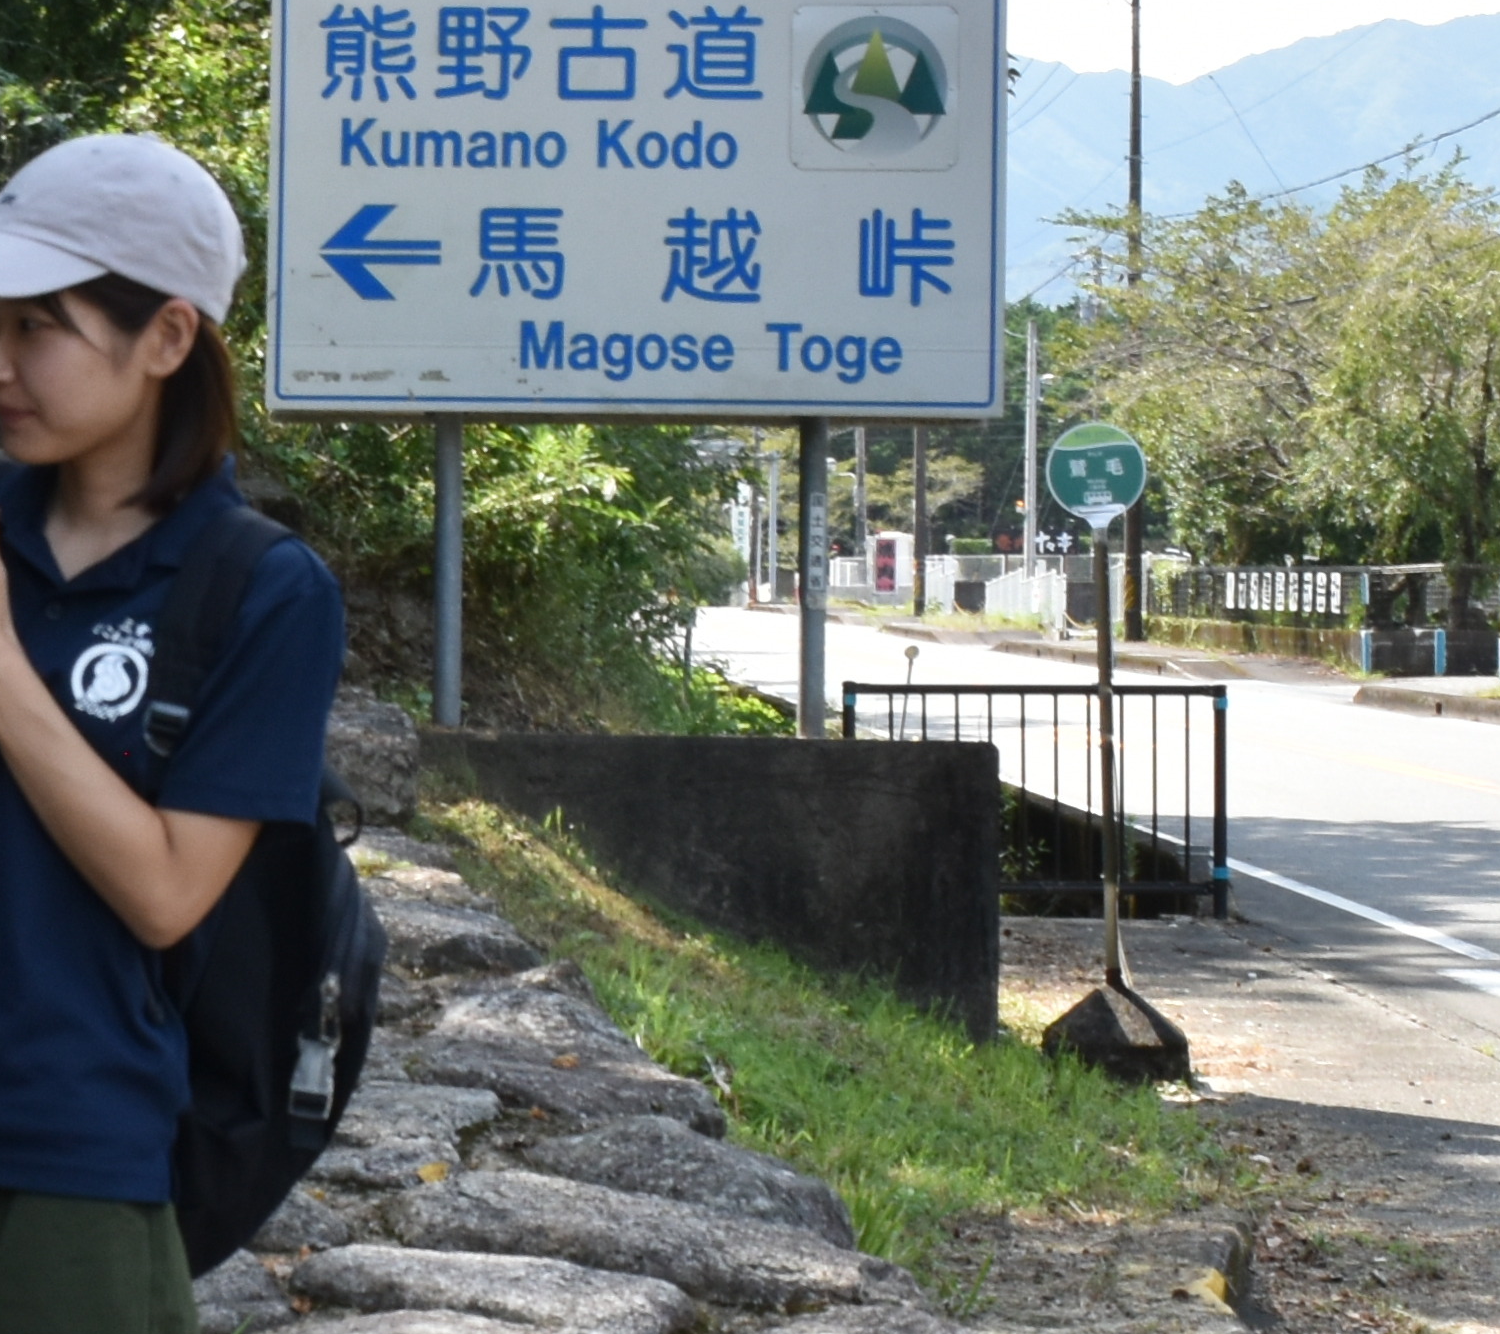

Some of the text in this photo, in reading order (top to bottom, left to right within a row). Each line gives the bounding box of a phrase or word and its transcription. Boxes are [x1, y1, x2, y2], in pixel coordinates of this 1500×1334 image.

[319, 4, 766, 103] 熊野古道
[340, 117, 741, 170] Kumano Kodo
[469, 206, 957, 307] 馬越峠
[519, 319, 905, 385] Magose Toge
